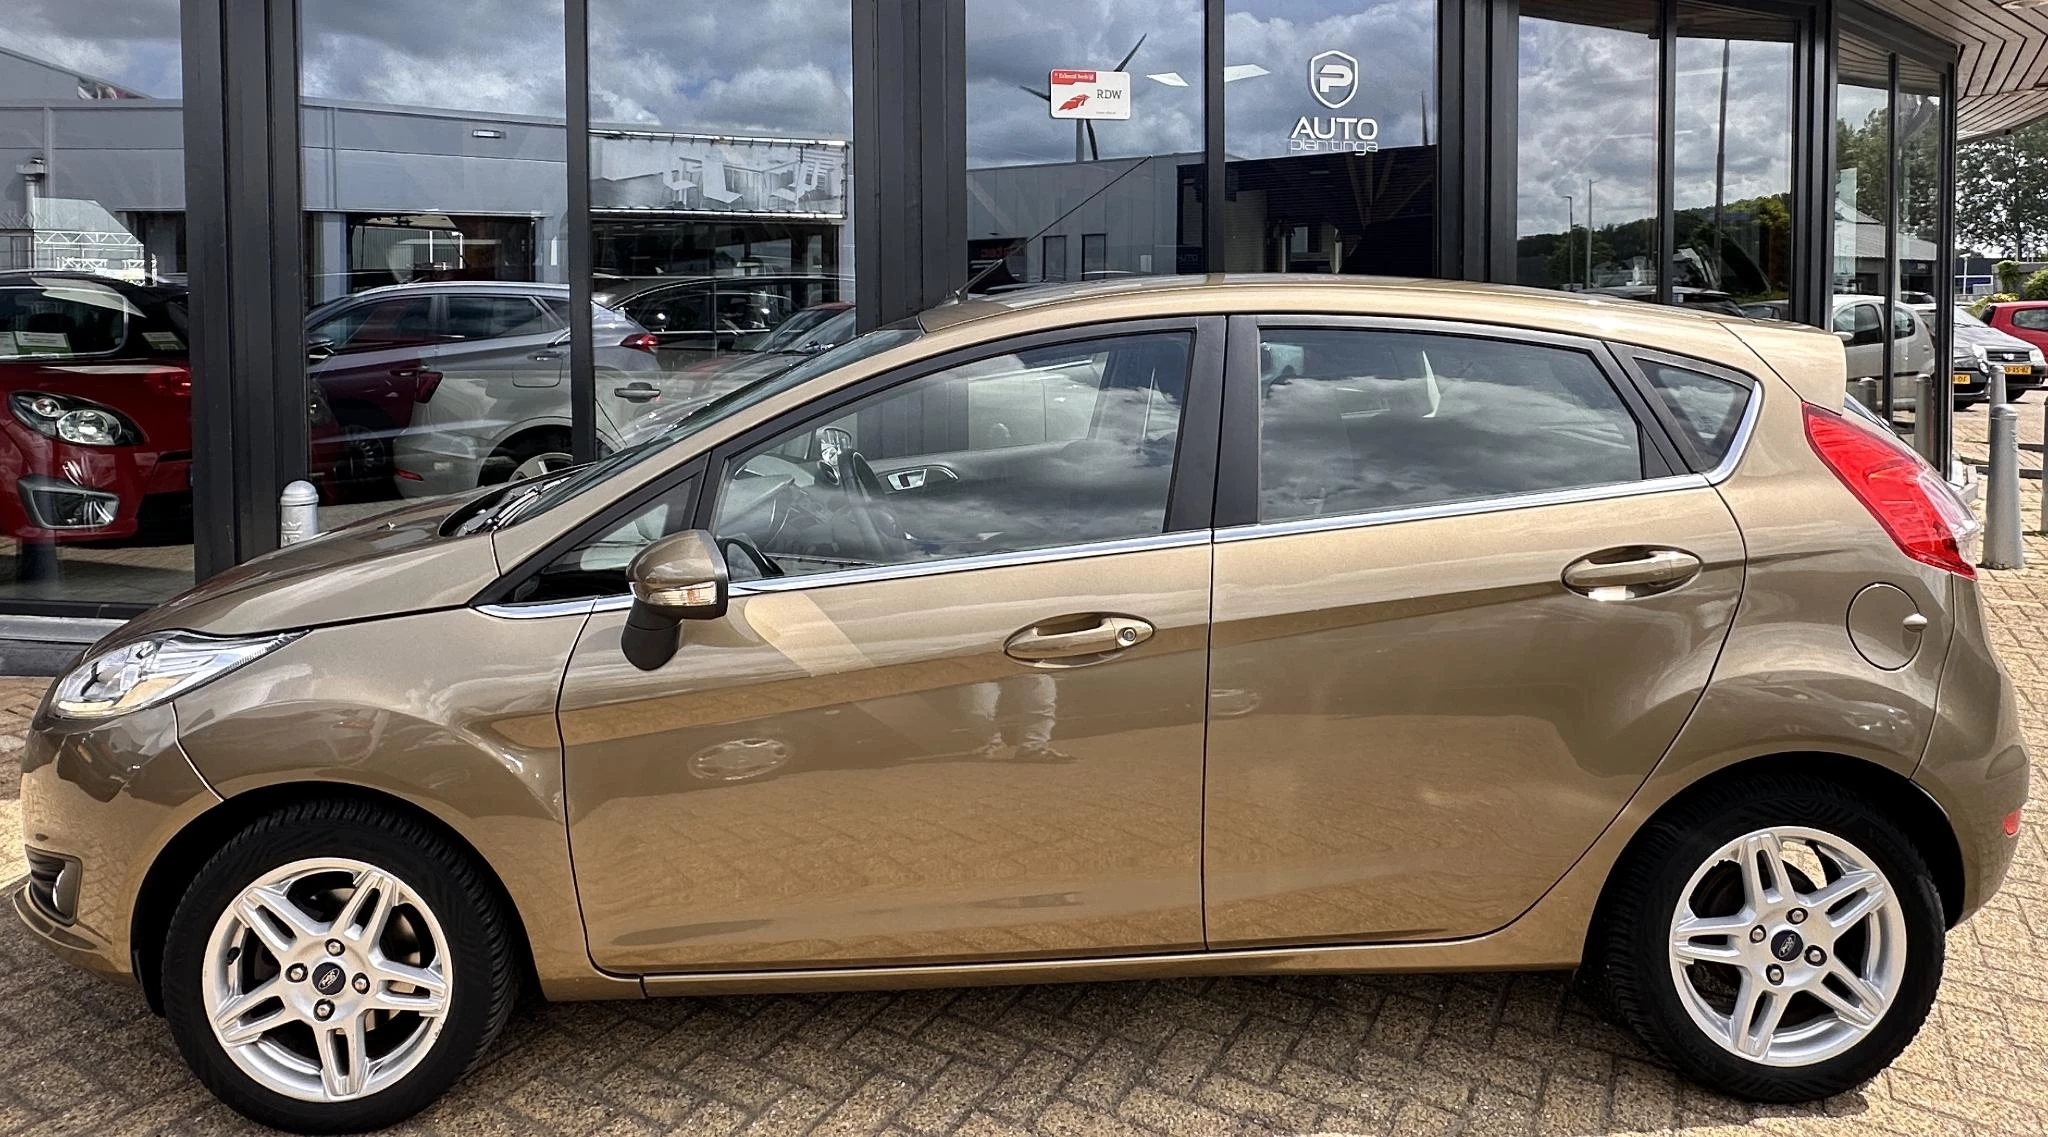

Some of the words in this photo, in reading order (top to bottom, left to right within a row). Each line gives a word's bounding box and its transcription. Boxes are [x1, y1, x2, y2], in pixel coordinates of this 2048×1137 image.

[1096, 89, 1123, 99] RDW
[1291, 116, 1378, 140] AUTO
[1290, 138, 1378, 156] plantinga
